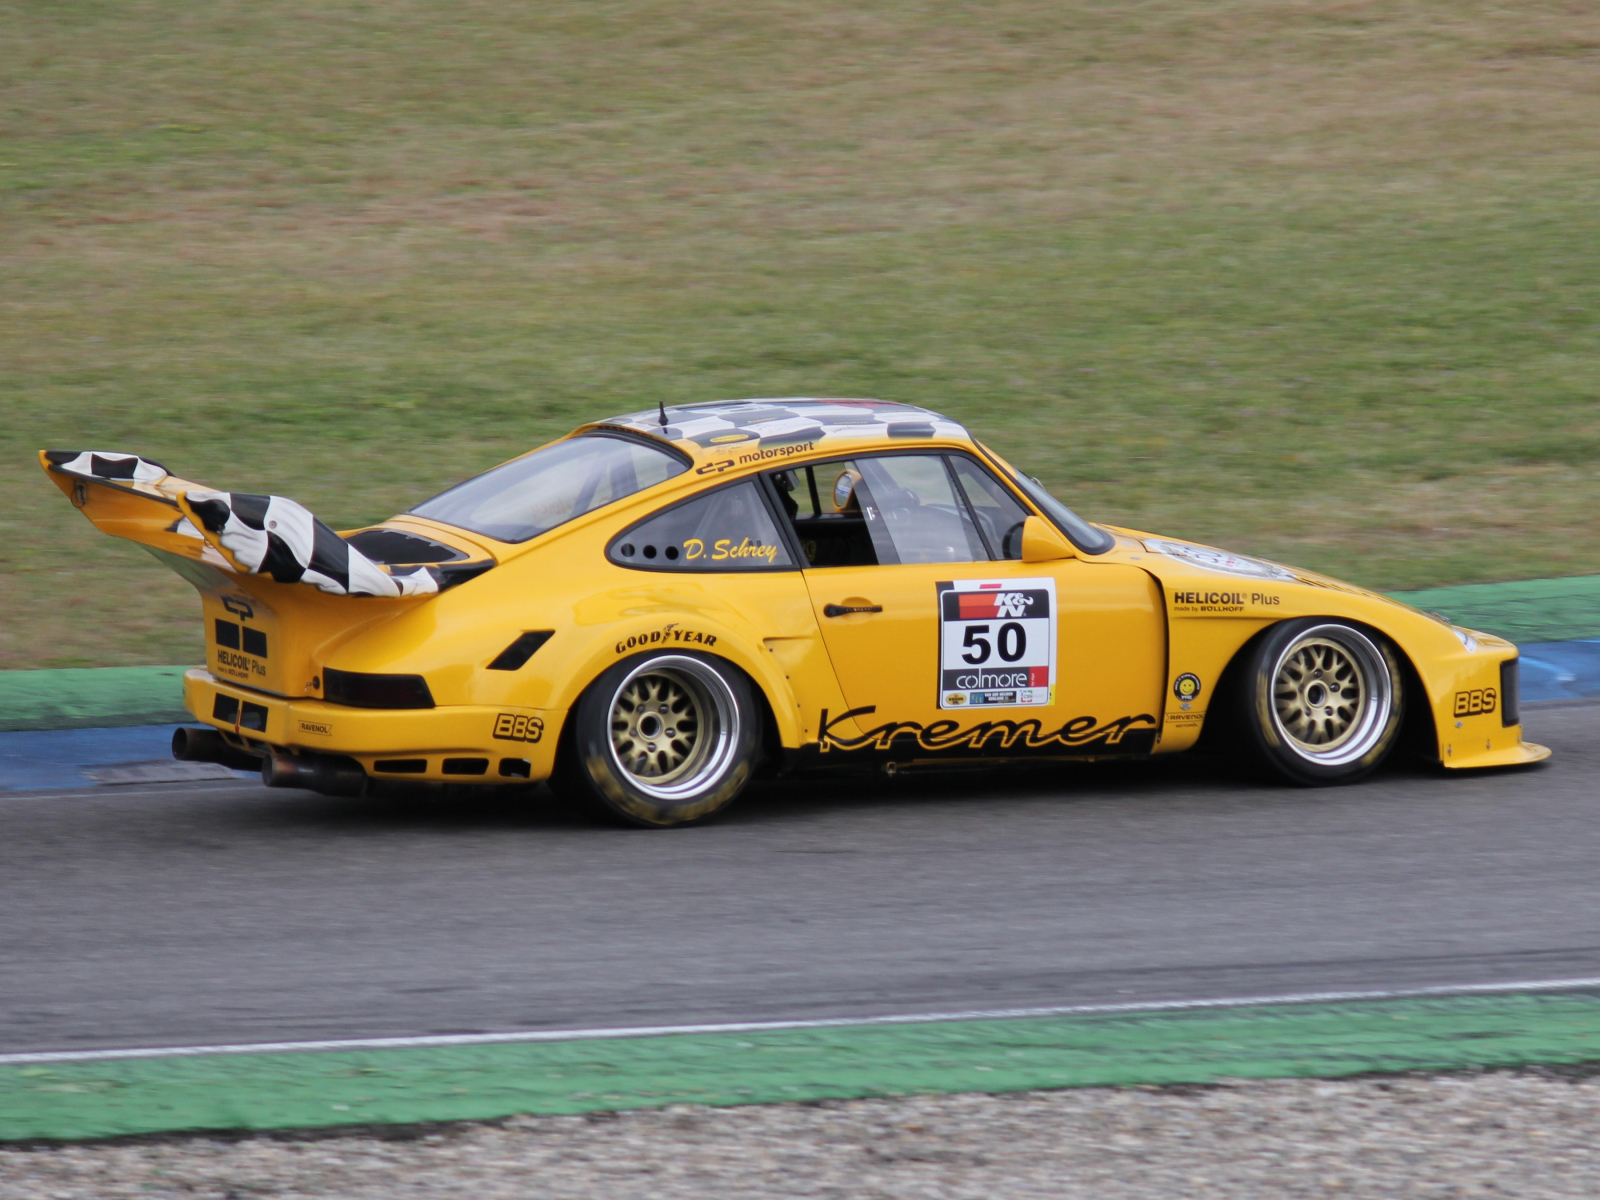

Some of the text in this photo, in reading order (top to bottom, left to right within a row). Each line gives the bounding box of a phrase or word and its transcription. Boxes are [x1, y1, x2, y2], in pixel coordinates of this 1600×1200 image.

[739, 441, 814, 464] motorsport
[683, 538, 707, 560] D.
[711, 537, 778, 563] Schrey
[1251, 593, 1280, 605] Plus
[961, 622, 1027, 665] 50
[252, 659, 266, 676] Plus
[956, 668, 1028, 689] colmore
[1454, 687, 1497, 718] BBS
[301, 722, 328, 734] RAVENOL
[492, 713, 544, 744] BBS
[817, 704, 1156, 752] Kremer
